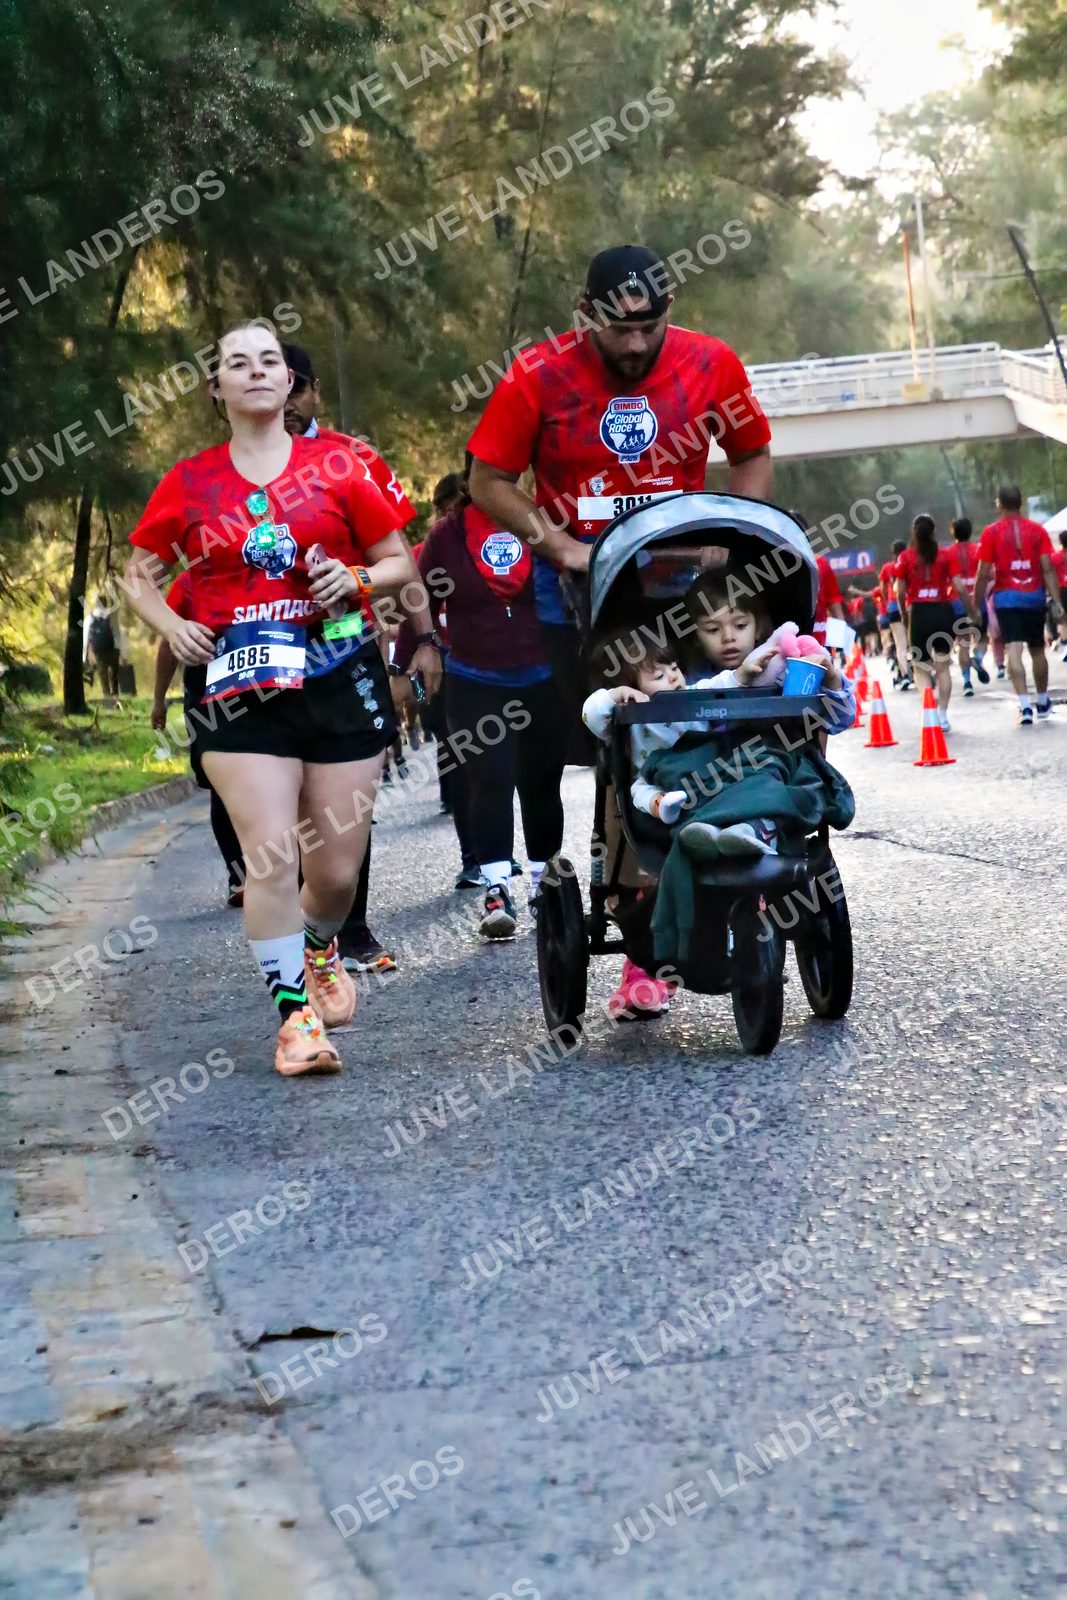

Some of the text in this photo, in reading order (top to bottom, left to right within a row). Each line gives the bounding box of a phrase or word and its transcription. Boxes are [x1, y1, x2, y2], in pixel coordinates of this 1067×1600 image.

[614, 402, 643, 411] BIMBO
[614, 413, 643, 424] Global
[608, 423, 632, 433] Race
[613, 495, 652, 516] 30
[251, 549, 274, 559] Race
[227, 646, 270, 672] 4685
[695, 707, 728, 718] Jeep
